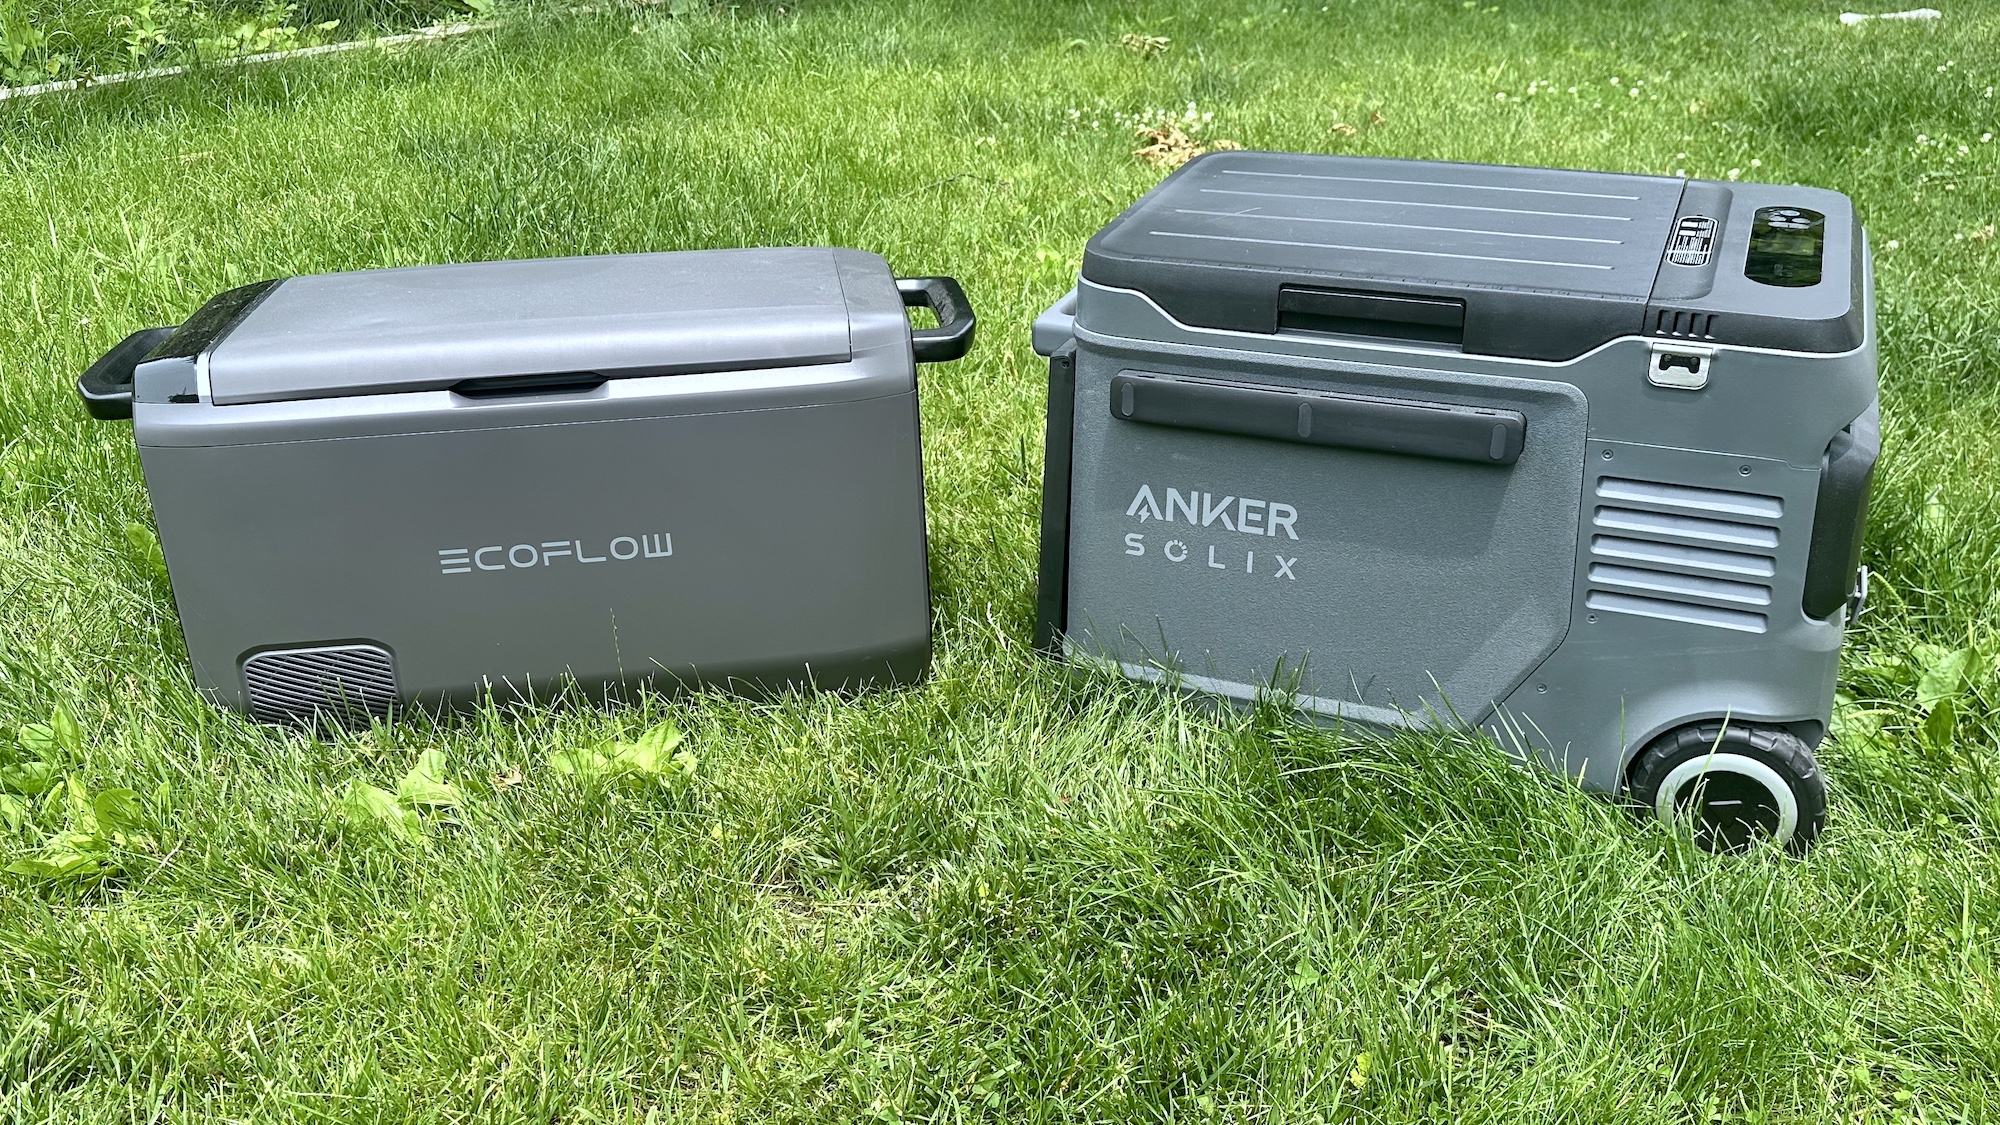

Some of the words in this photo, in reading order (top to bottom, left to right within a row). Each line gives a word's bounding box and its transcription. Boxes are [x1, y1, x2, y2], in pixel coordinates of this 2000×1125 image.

[1126, 484, 1299, 540] ANKER
[438, 533, 673, 574] ECOFLOW
[1124, 533, 1298, 580] SOLIX
